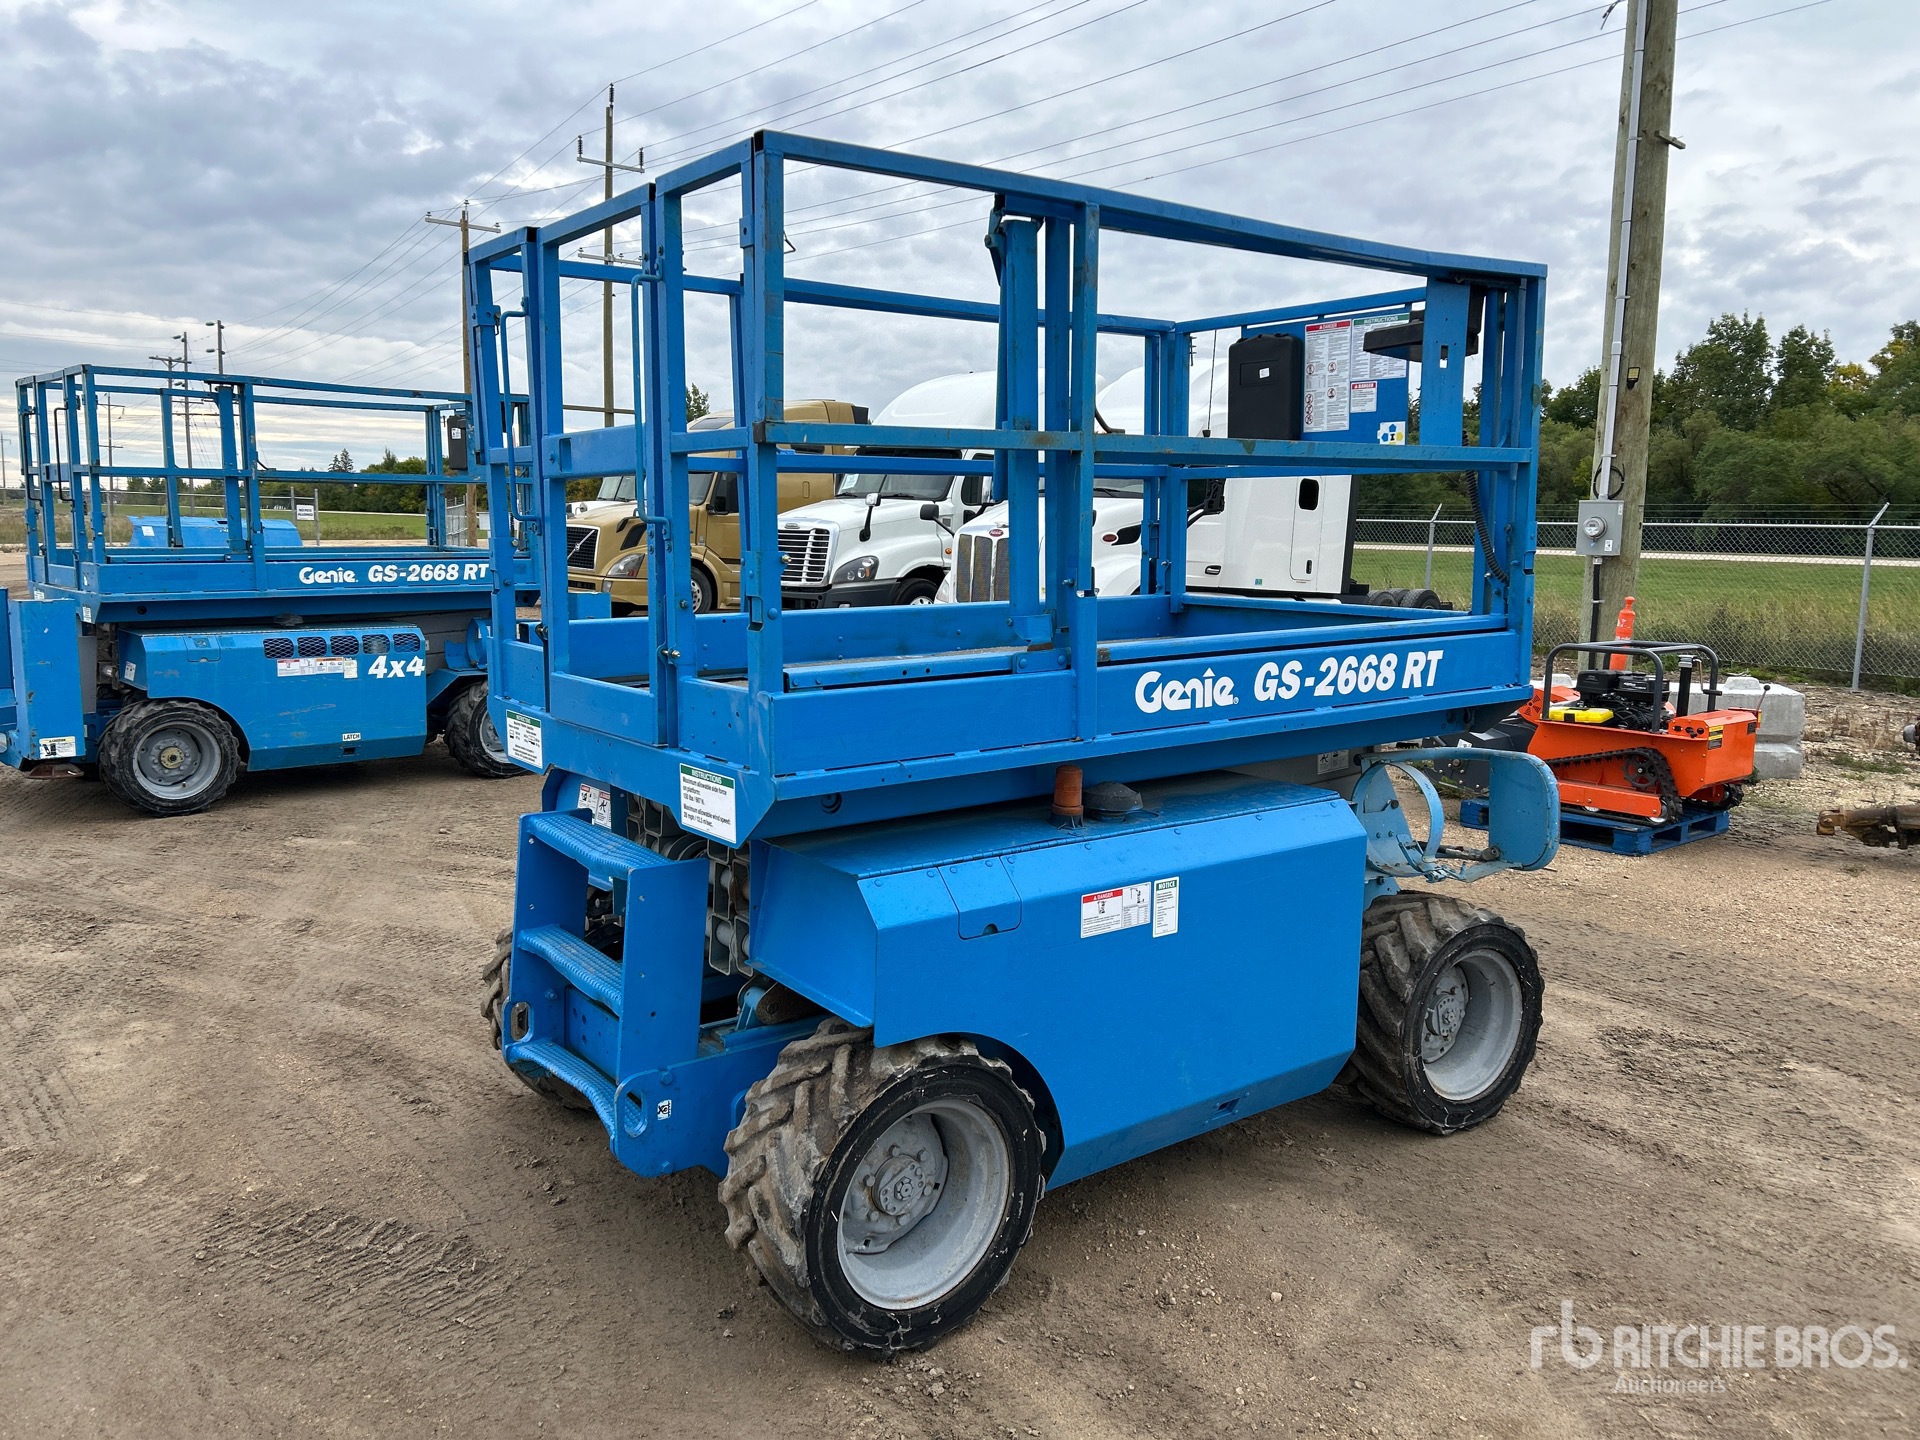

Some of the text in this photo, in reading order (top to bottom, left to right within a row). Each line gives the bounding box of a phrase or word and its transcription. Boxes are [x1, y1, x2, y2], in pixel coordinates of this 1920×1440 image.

[299, 563, 490, 584] Genie GS-2668 RT
[367, 655, 426, 679] 4x4
[1134, 650, 1445, 714] Genie GS-2668 RT
[691, 769, 723, 785] INSTRUCTIONS
[1158, 881, 1176, 890] NOTICE
[1097, 891, 1114, 900] DANGER
